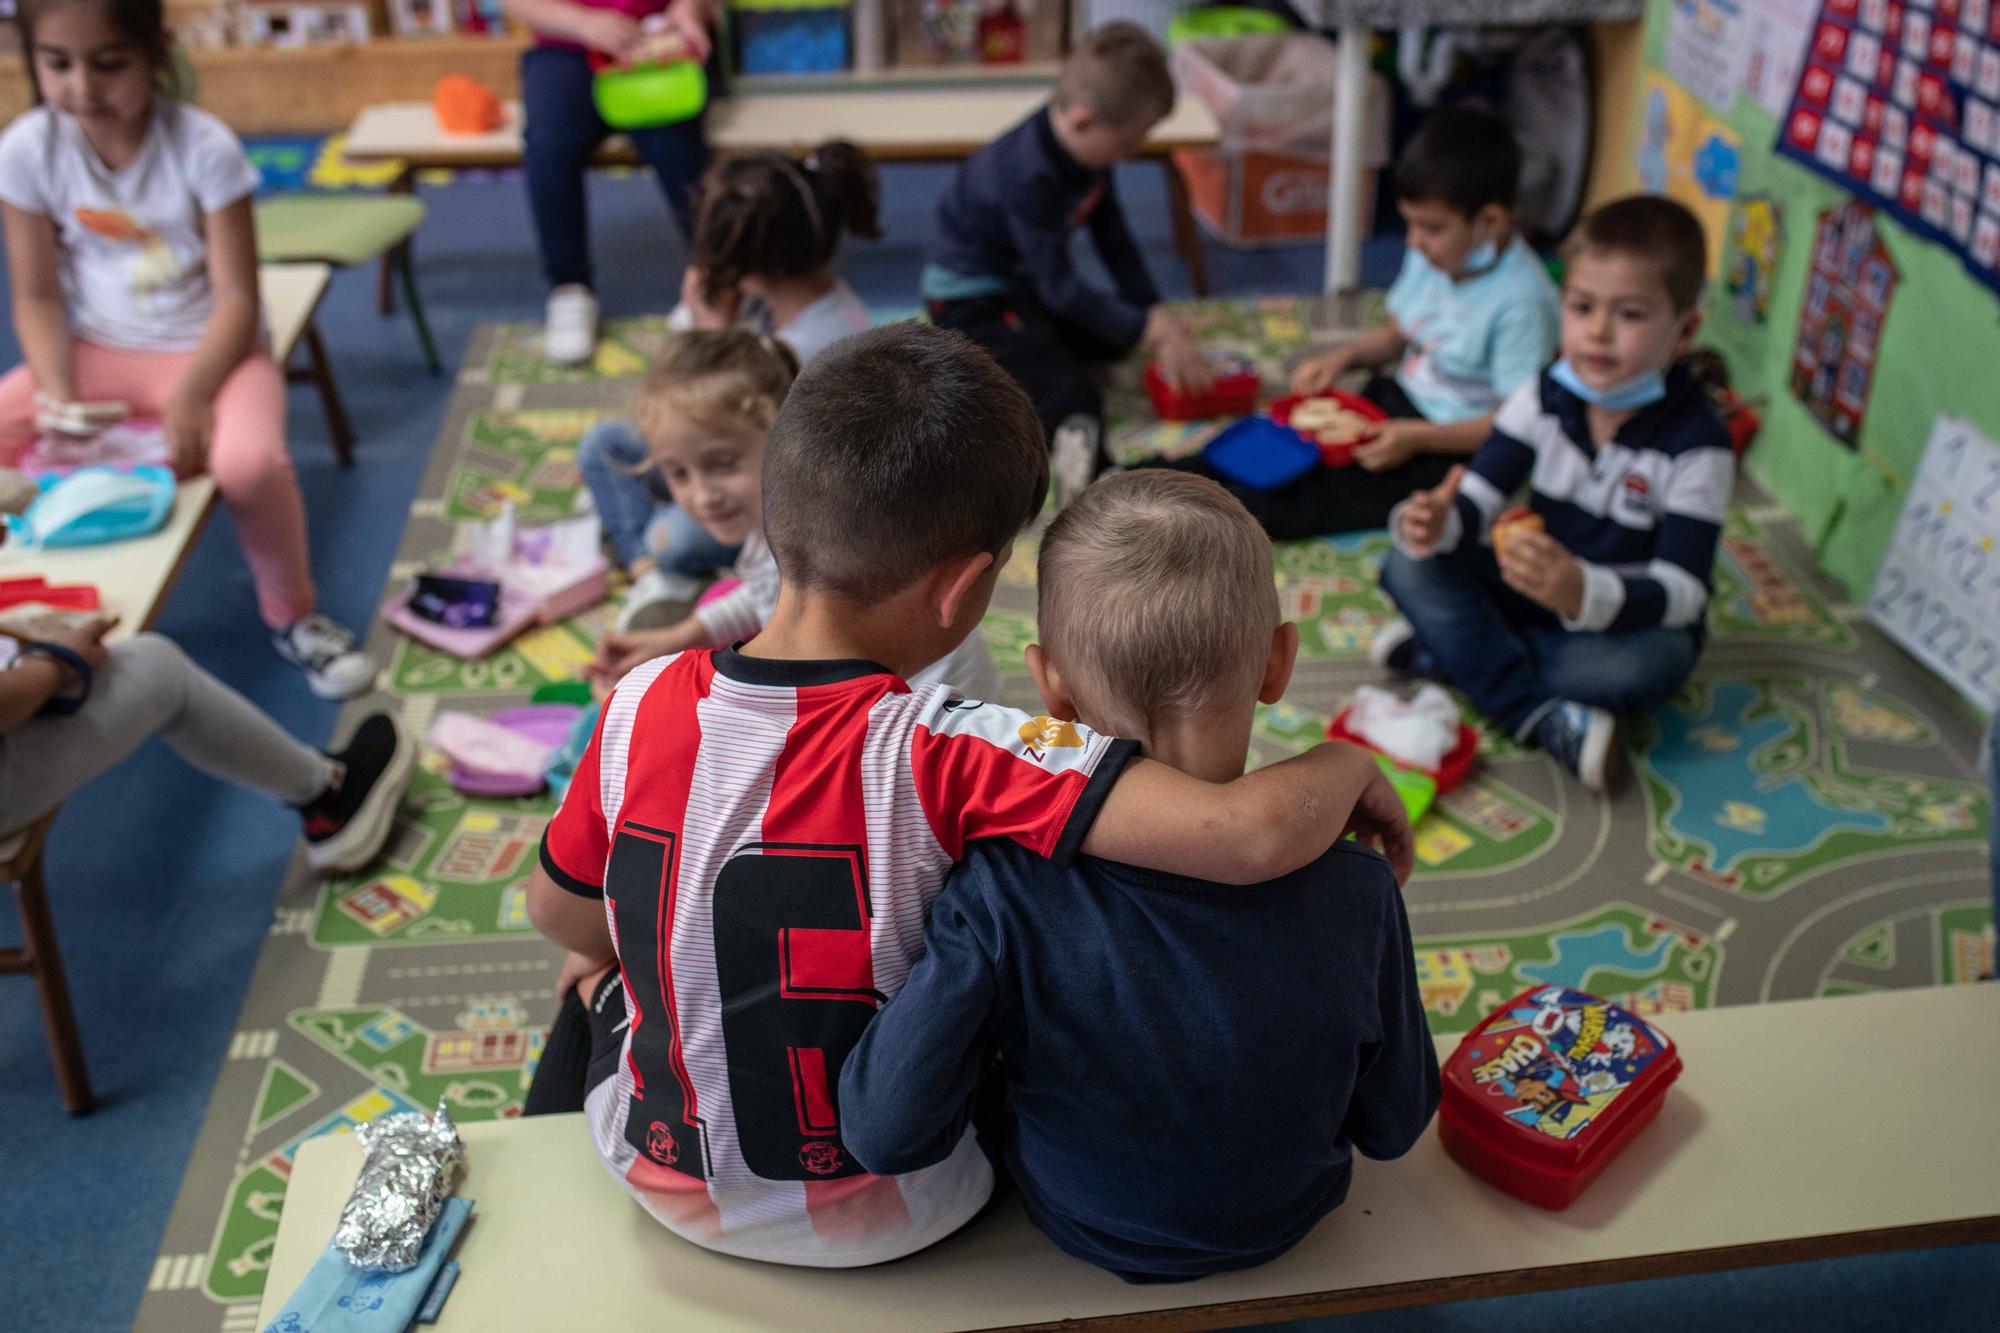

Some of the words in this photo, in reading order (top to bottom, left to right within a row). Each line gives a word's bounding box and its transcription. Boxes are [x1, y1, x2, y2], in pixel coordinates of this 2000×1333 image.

[1943, 435, 1968, 480] 1
[1944, 535, 1990, 595] 12
[1921, 601, 1972, 667] 22
[606, 821, 888, 1181] 16
[1471, 1035, 1542, 1084] CHASE
